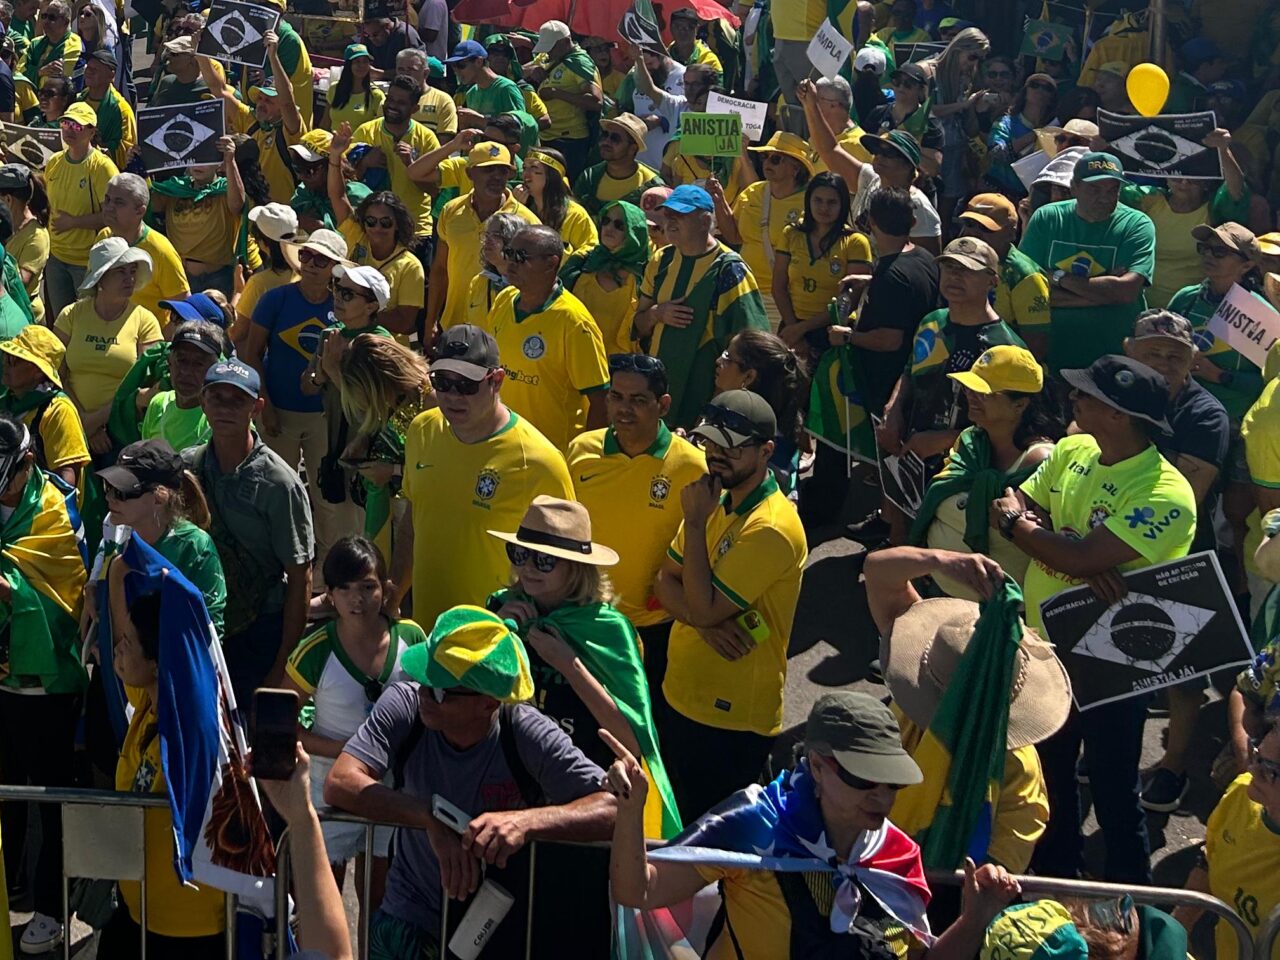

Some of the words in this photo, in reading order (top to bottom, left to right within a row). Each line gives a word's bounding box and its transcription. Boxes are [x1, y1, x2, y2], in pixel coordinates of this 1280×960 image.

[816, 29, 842, 63] AMPLA
[716, 95, 757, 110] DEMOCRACIA
[682, 118, 740, 136] ANISTIA
[1087, 160, 1120, 172] BRASIL
[1045, 600, 1084, 619] DEMOCRACIA
